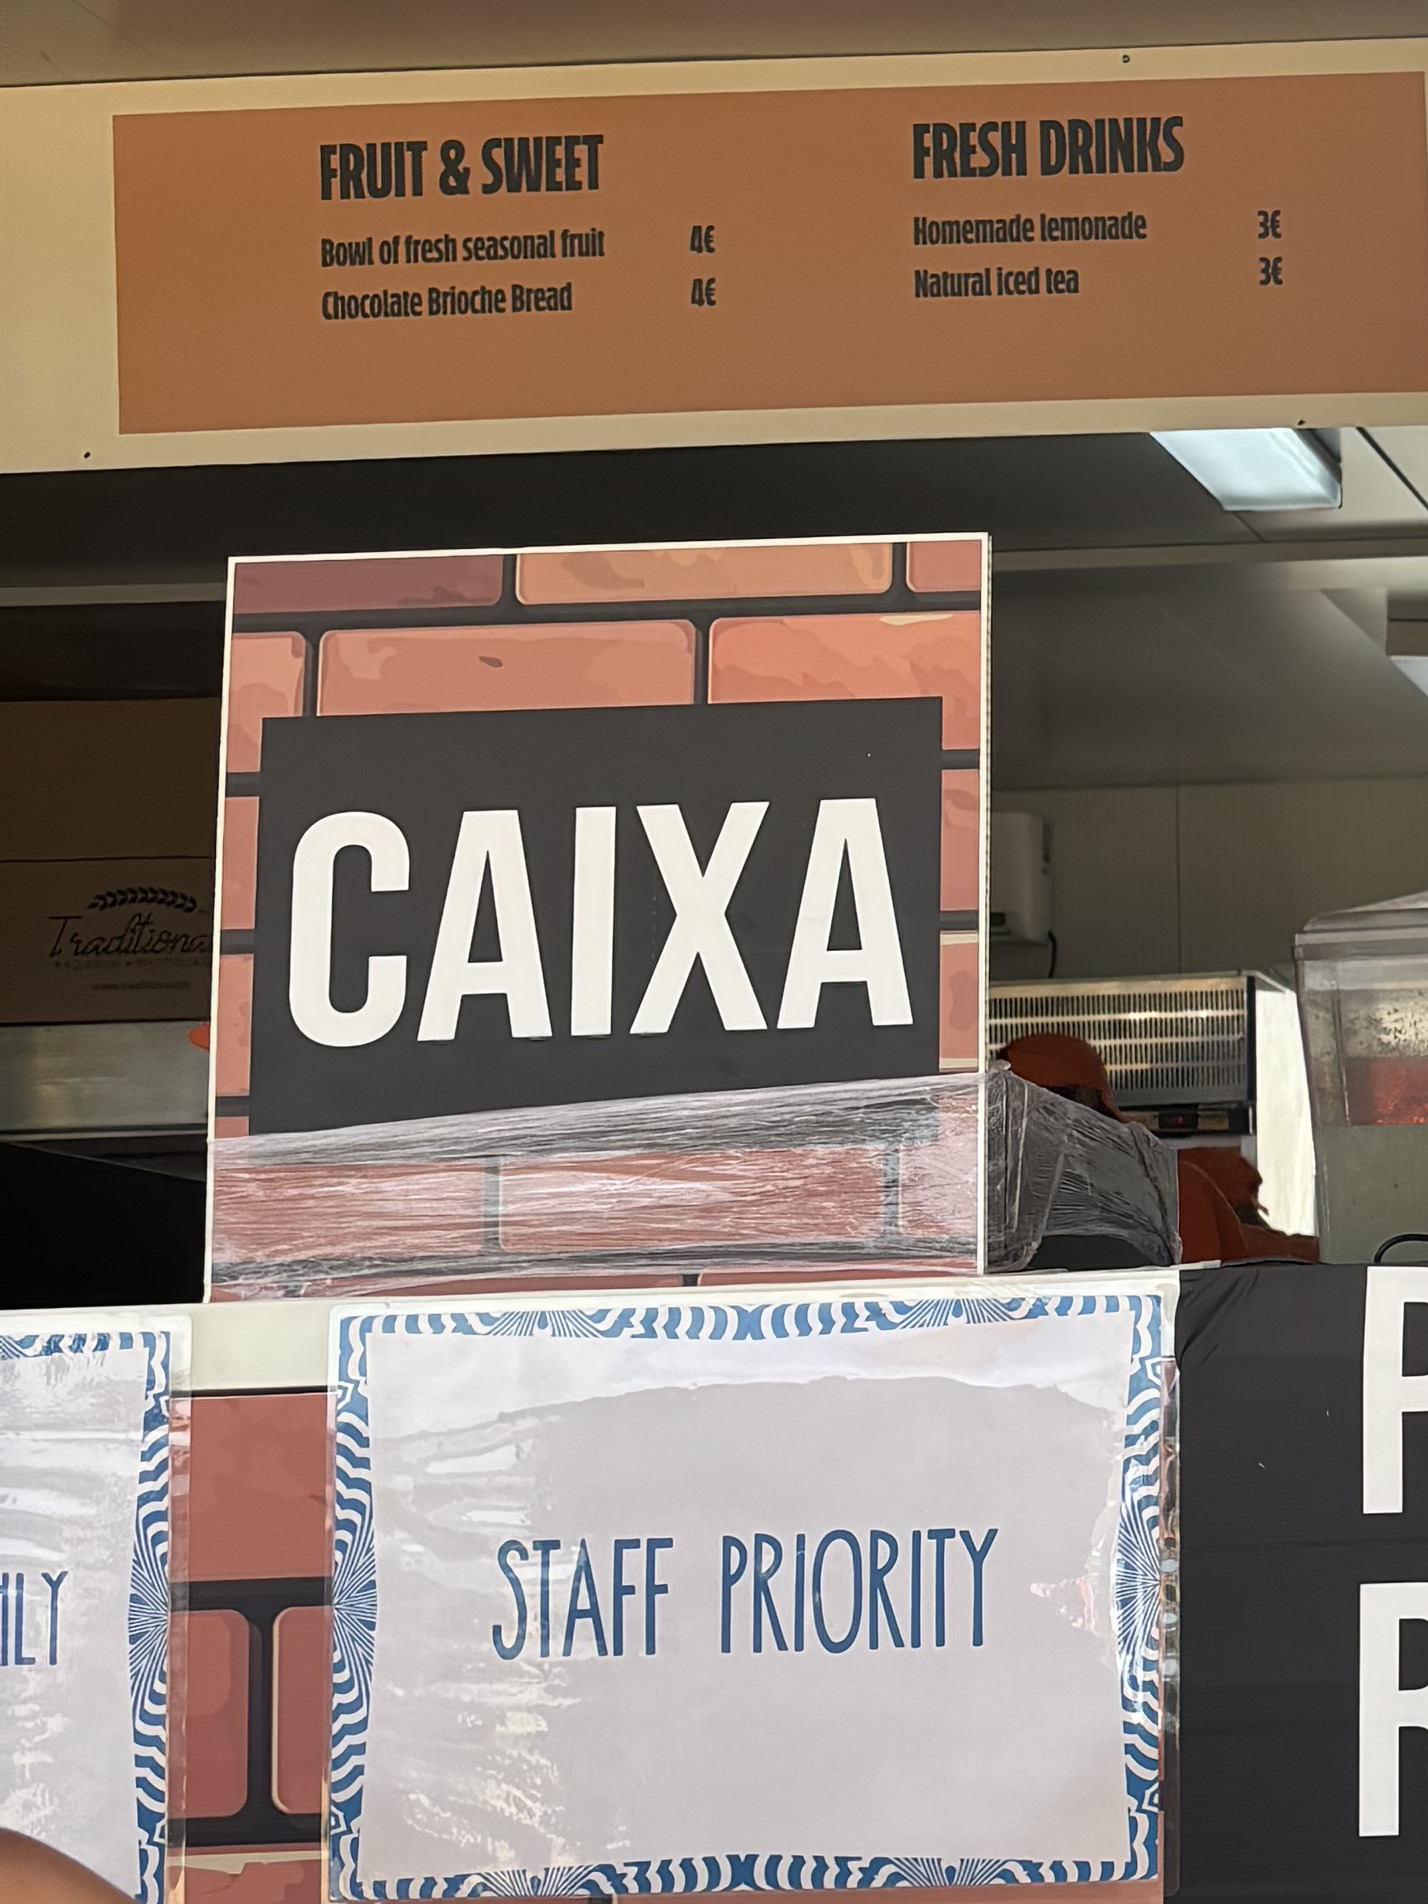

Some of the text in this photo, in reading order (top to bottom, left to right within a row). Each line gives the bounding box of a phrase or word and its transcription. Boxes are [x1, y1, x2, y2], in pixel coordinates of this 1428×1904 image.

[319, 133, 605, 201] FRUIT & SWEET
[912, 115, 1185, 180] FRESH DRINKS
[689, 224, 716, 254] 4€
[913, 210, 1148, 246] Homemade lemonade
[1256, 209, 1283, 240] 3€
[320, 227, 606, 268] Bowl of fresh seasonal fruit
[914, 265, 1080, 299] Natural iced tea
[1258, 256, 1284, 286] 3€
[321, 281, 573, 321] Chocolate Brioche Bread
[690, 276, 717, 307] 4€
[45, 912, 212, 958] Traditiona
[288, 797, 914, 1047] CAIXA
[492, 1527, 999, 1661] STAFF PRIORITY
